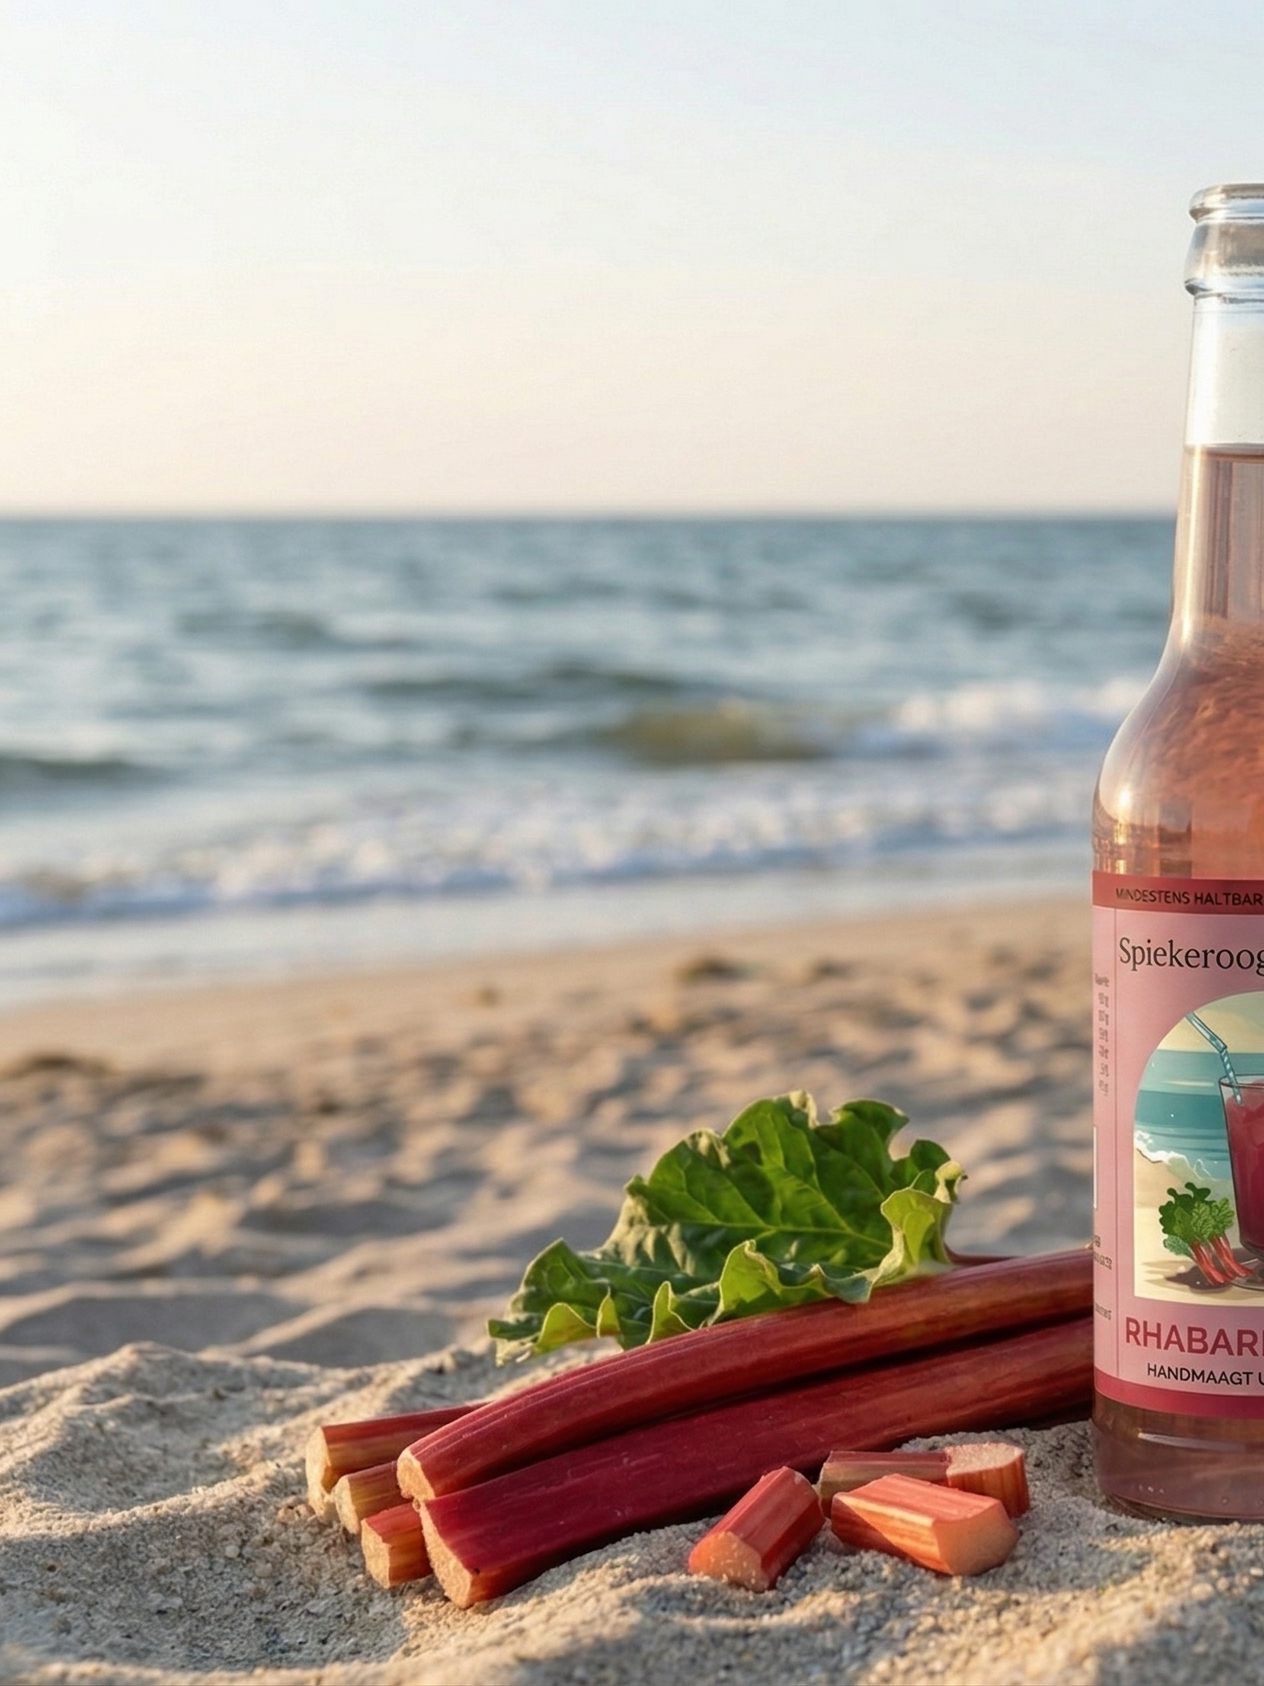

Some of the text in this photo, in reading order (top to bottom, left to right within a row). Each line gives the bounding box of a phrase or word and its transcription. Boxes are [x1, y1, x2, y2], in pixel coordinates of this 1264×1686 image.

[1115, 888, 1192, 905] MNDESTENS
[1194, 891, 1264, 906] HALTBAR
[1147, 1362, 1254, 1385] HANDMAAGT
